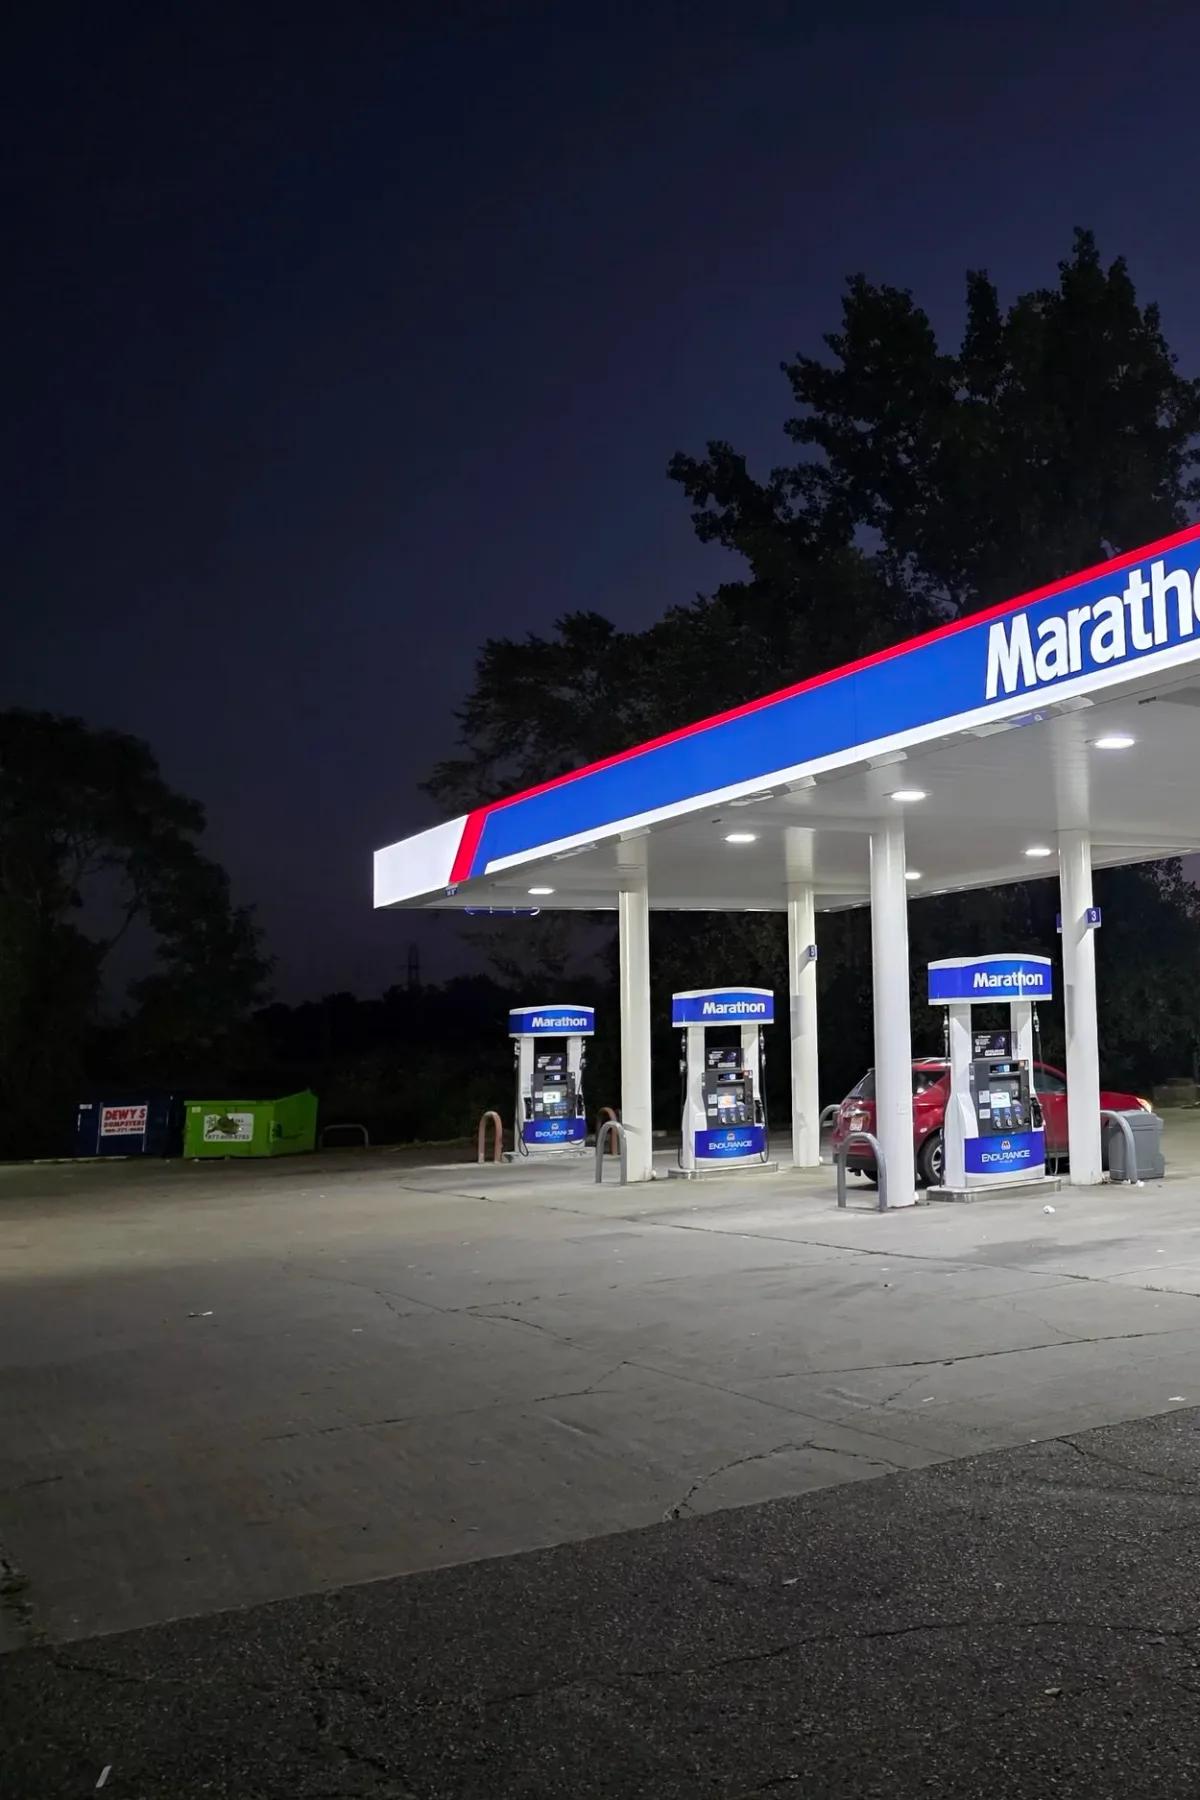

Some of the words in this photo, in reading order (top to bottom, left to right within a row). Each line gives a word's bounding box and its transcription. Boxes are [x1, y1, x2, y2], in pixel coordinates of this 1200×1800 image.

[1091, 910, 1097, 921] 3
[973, 971, 1043, 988] Marathon
[702, 1001, 765, 1015] Marathon
[531, 1016, 587, 1028] Marathon
[708, 1140, 753, 1150] ENDURANCE
[981, 1149, 1031, 1163] ENDURANCE
